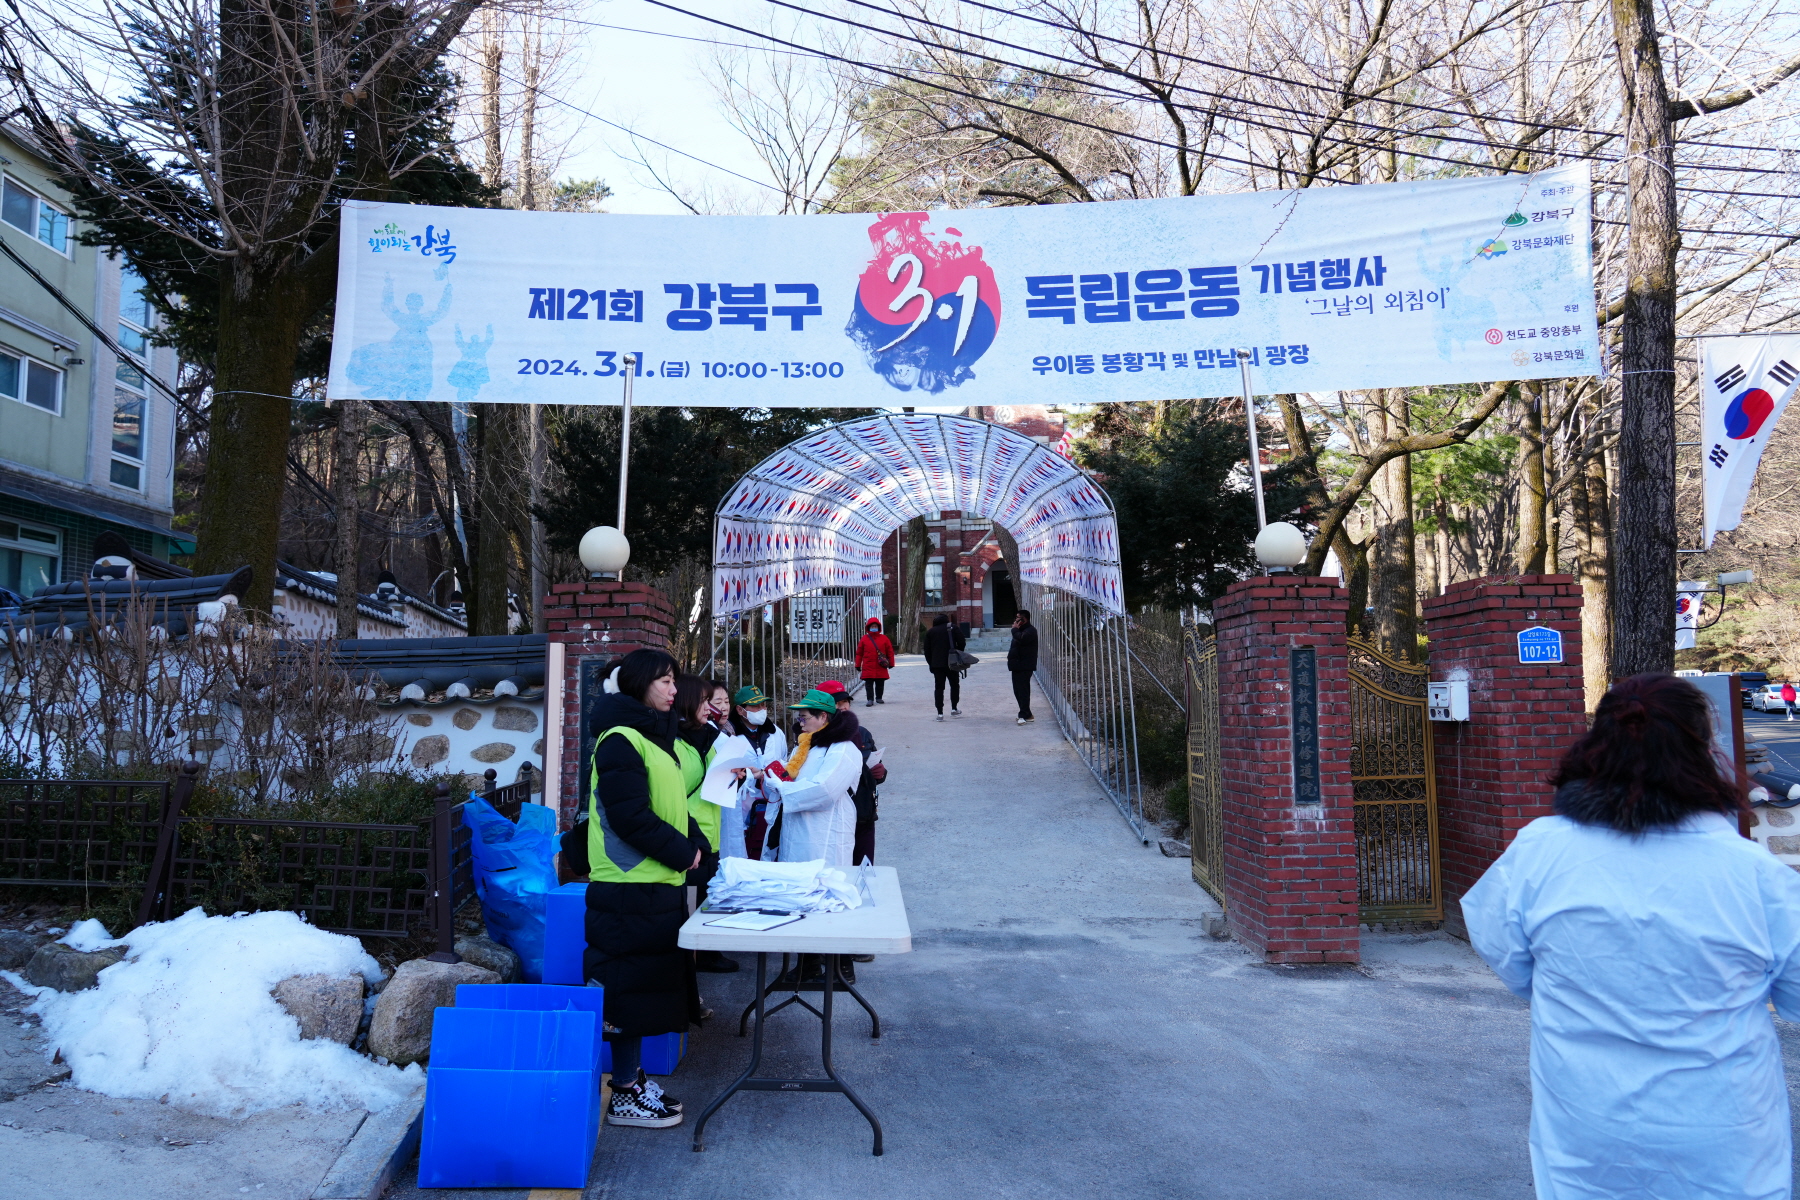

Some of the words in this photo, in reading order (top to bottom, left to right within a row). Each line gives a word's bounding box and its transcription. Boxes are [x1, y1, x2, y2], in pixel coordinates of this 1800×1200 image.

[1531, 207, 1575, 223] 강북구
[410, 224, 457, 265] 강북
[1511, 233, 1575, 251] 강북문화재단
[527, 287, 644, 323] 제21회
[663, 282, 823, 332] 강북구
[1025, 265, 1240, 325] 독립운동
[1250, 254, 1388, 295] 기념행사
[1563, 303, 1579, 313] 후원
[1506, 328, 1538, 341] 천도교
[1539, 324, 1582, 339] 중앙총부
[1032, 354, 1096, 376] 우이동
[1101, 351, 1167, 374] 봉황각
[1171, 352, 1189, 369] 및
[1265, 343, 1310, 366] 광장
[1532, 348, 1585, 363] 강북문화원
[516, 358, 588, 377] 2024.
[1523, 645, 1558, 658] 107-12
